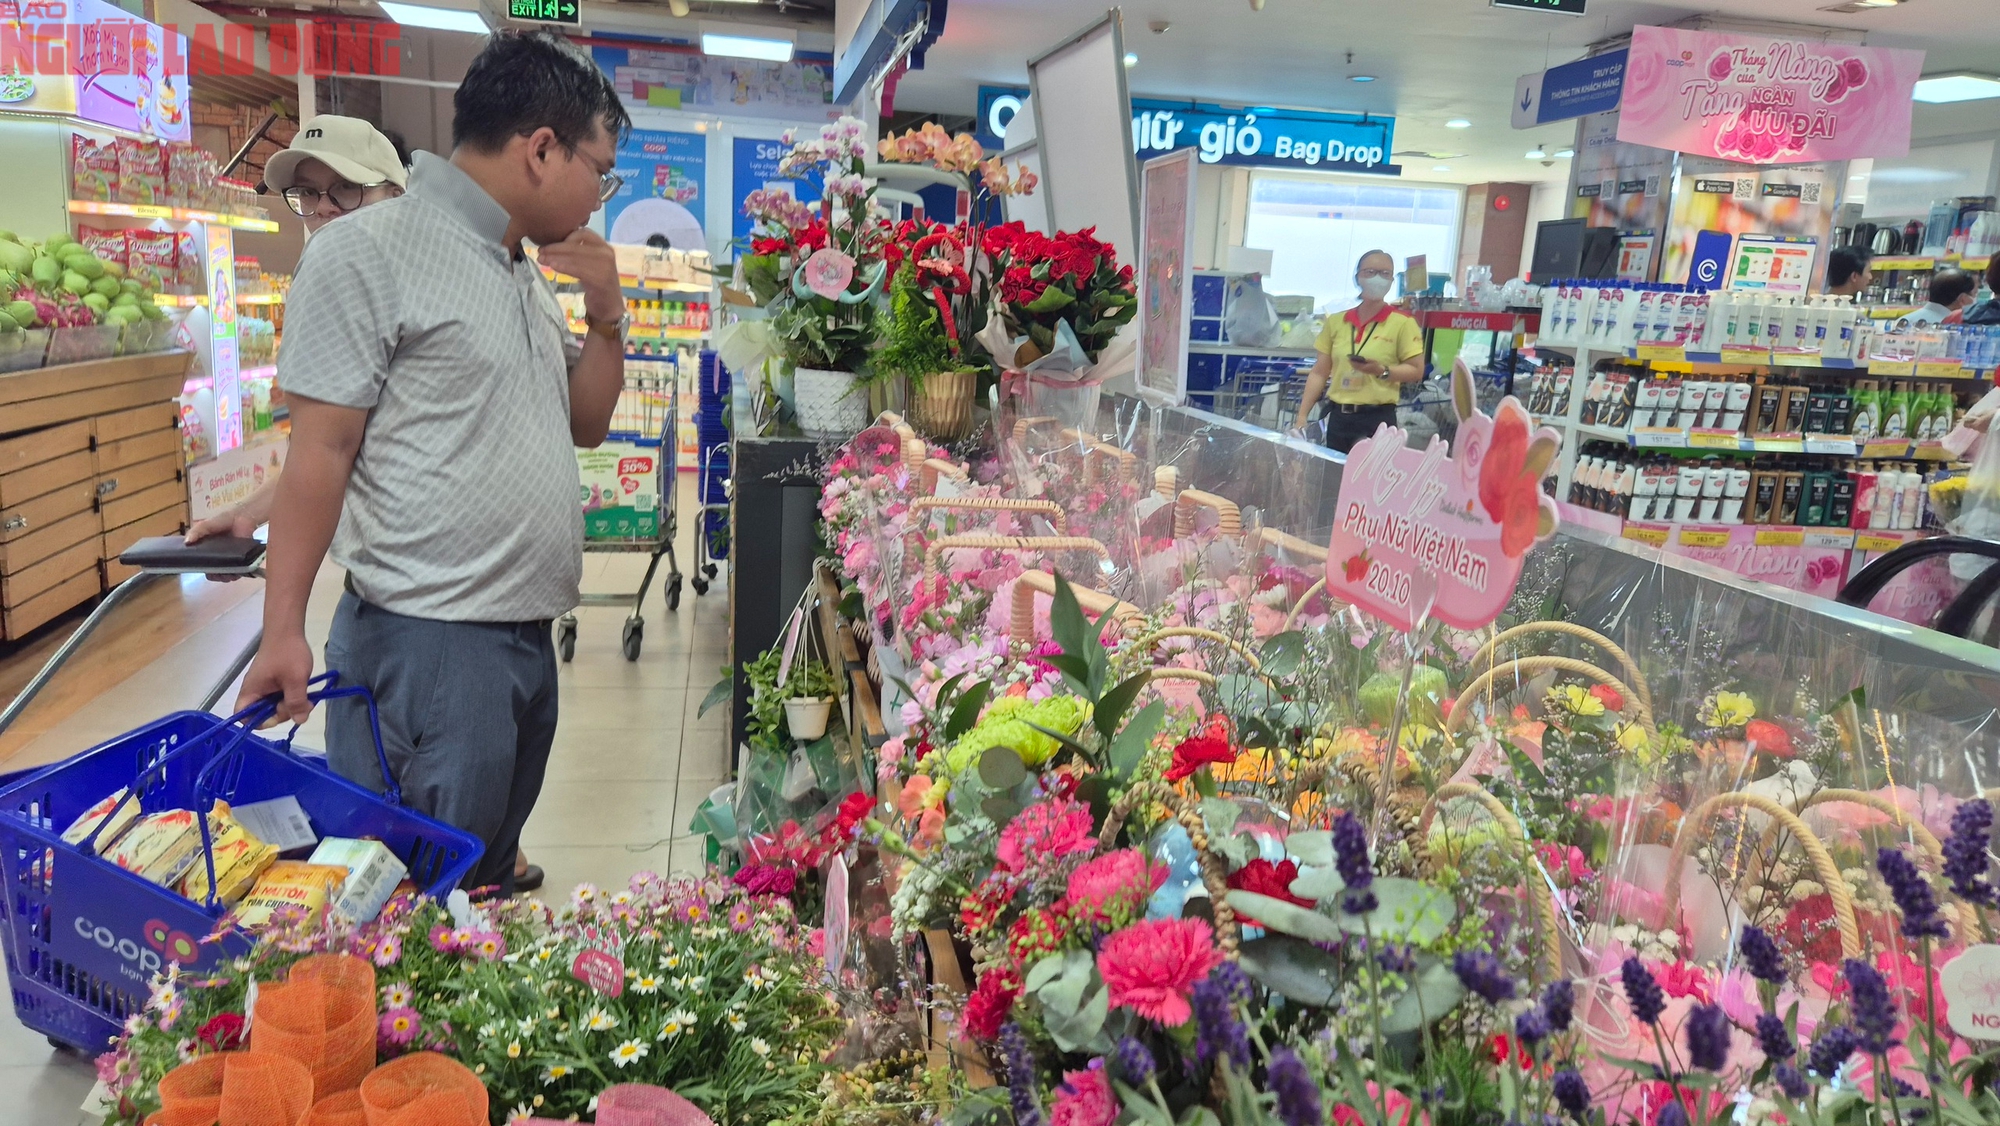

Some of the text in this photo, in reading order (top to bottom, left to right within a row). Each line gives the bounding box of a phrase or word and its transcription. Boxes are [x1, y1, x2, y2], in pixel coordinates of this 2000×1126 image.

[512, 5, 536, 17] EXIT
[1593, 67, 1609, 78] TRUY
[1732, 42, 1838, 98] Tháng Nàng
[1736, 69, 1756, 83] của
[1571, 87, 1581, 96] TIN
[1581, 81, 1601, 93] KHÁCH
[1750, 86, 1796, 106] NGÀN
[1680, 79, 1747, 131] Tặng
[1751, 107, 1837, 139] ƯU ĐÃI
[1200, 115, 1262, 163] giỏ
[1275, 137, 1320, 165] Bag
[1327, 139, 1383, 168] Drop
[1451, 316, 1488, 330] ĐỒNG GIÁ
[621, 462, 649, 473] 30%
[1343, 501, 1488, 591] Phụ Nữ Việt Nam
[1367, 563, 1410, 605] 20.10
[282, 885, 309, 899] TÔM
[74, 916, 161, 972] co.op
